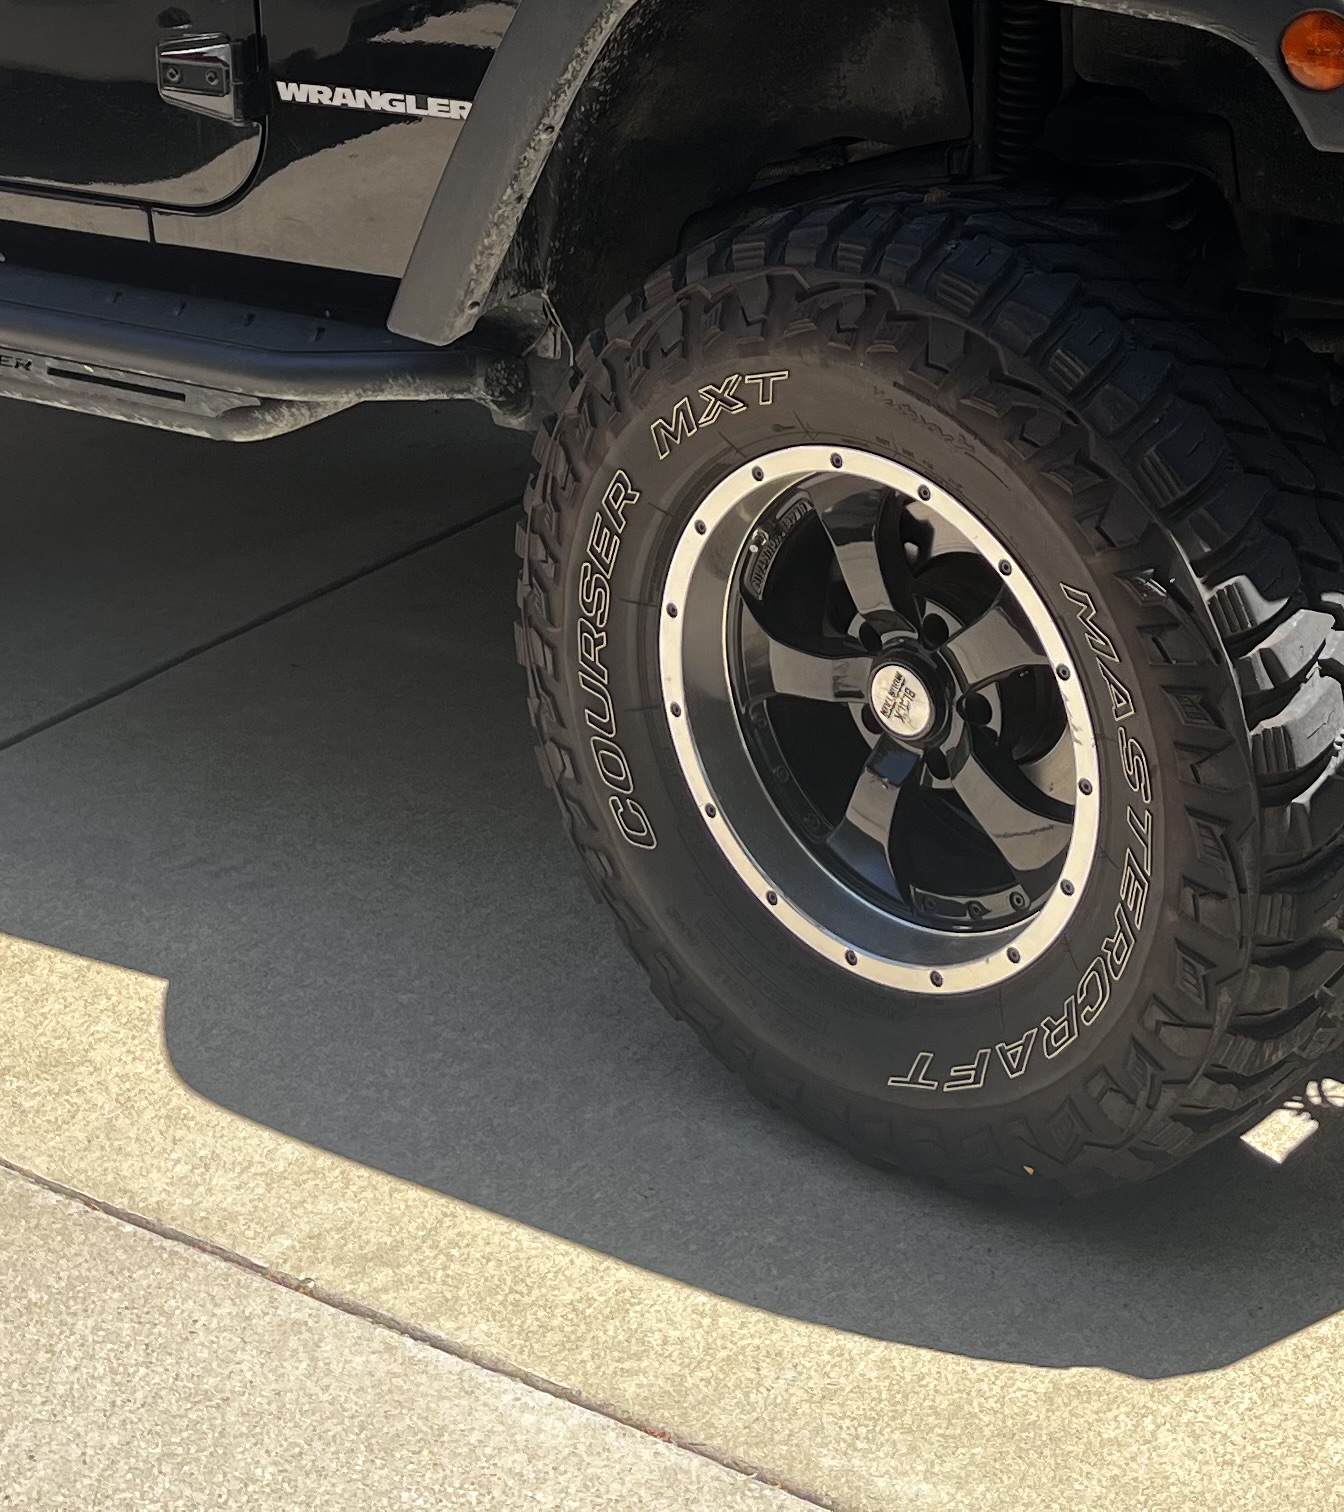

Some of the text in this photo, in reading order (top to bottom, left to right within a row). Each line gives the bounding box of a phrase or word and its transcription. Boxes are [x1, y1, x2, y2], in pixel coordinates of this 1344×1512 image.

[275, 80, 473, 120] WRANGLER
[577, 369, 790, 850] COURSER MXT
[888, 582, 1154, 1092] MASTERCRAFT
